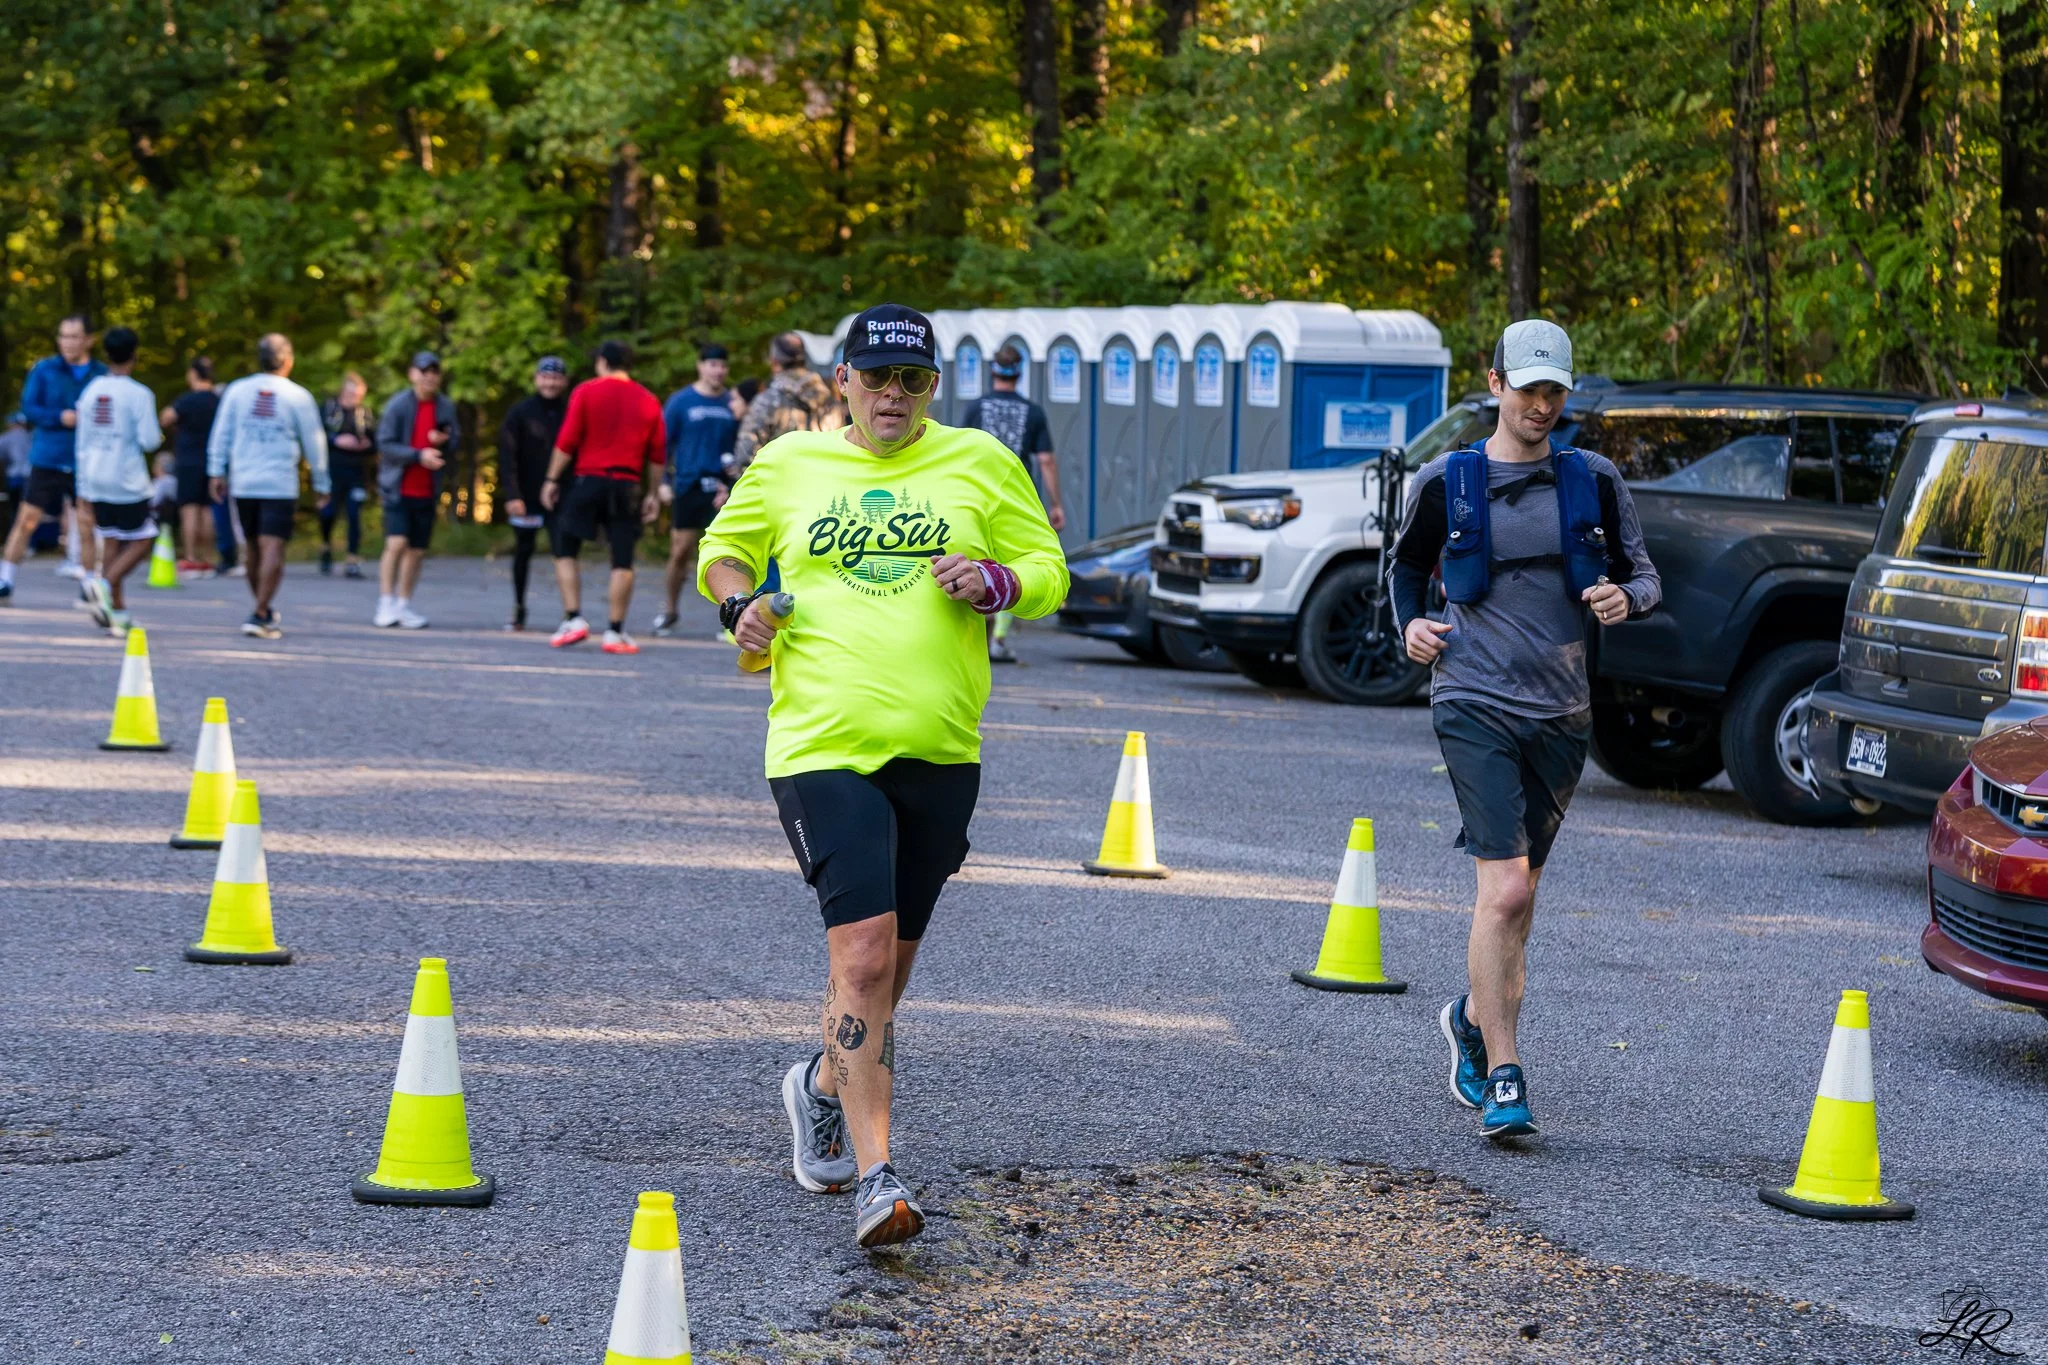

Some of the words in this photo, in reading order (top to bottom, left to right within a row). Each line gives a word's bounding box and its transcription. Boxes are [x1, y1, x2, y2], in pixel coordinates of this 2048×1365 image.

[867, 320, 926, 338] Running
[868, 333, 880, 346] is
[885, 331, 927, 350] dope.
[1535, 349, 1549, 358] OR
[808, 516, 873, 569] Big
[876, 512, 951, 551] Sur
[829, 560, 888, 597] INTERNATIONAL
[892, 563, 928, 595] MARATHON
